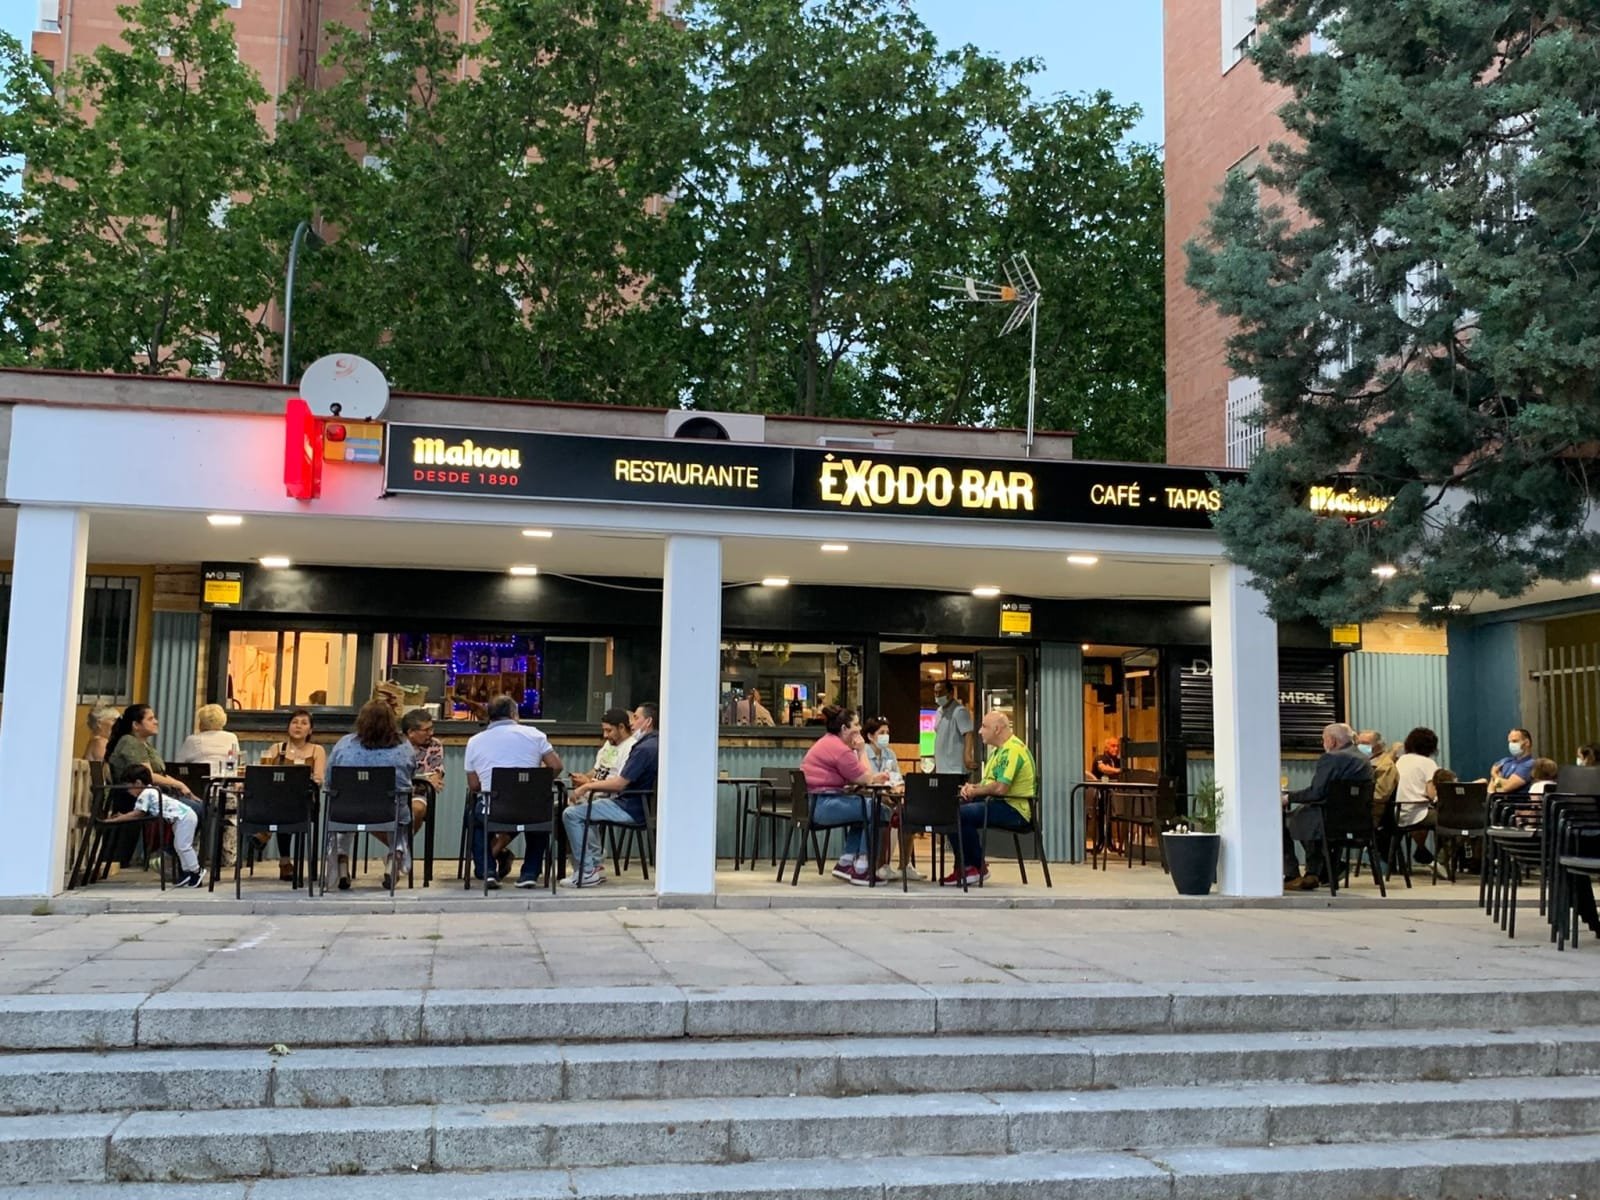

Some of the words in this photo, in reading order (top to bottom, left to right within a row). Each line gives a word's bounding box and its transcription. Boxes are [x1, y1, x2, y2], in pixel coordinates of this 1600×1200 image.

[412, 437, 521, 469] Mahou
[413, 470, 470, 484] DESDE
[479, 473, 518, 486] 1890
[615, 459, 759, 488] RESTAURANTE
[959, 469, 1034, 511] BAR
[1090, 481, 1140, 507] CAFÉ
[1164, 487, 1221, 511] TAPAS
[1192, 658, 1213, 676] D
[1278, 691, 1327, 704] MPRE
